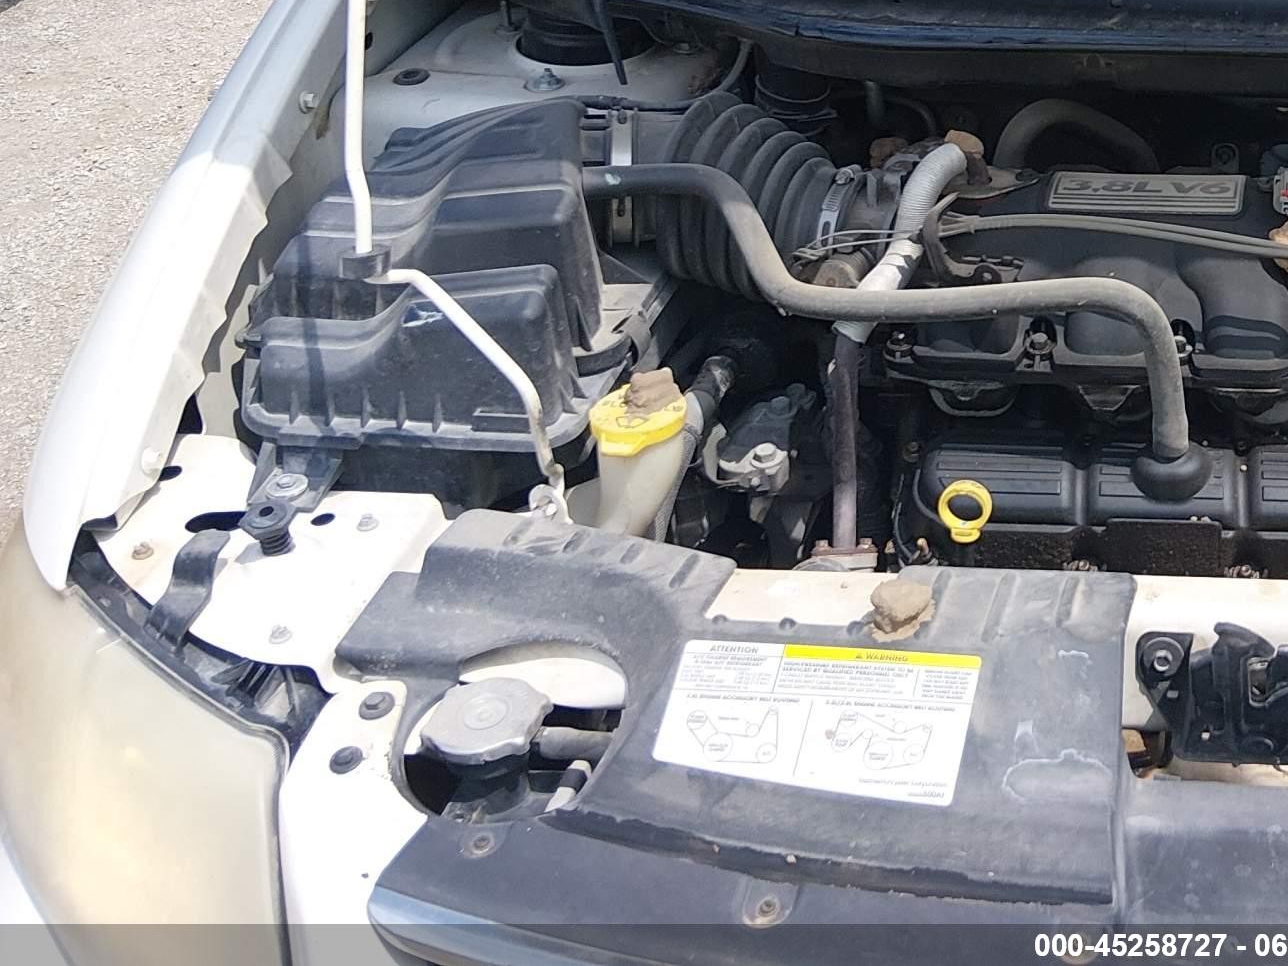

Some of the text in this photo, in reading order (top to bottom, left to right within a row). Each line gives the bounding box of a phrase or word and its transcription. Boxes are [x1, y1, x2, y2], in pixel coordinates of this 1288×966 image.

[1062, 179, 1231, 194] 3.8L V6
[709, 644, 760, 654] ATTENTION
[866, 652, 909, 663] WARNING
